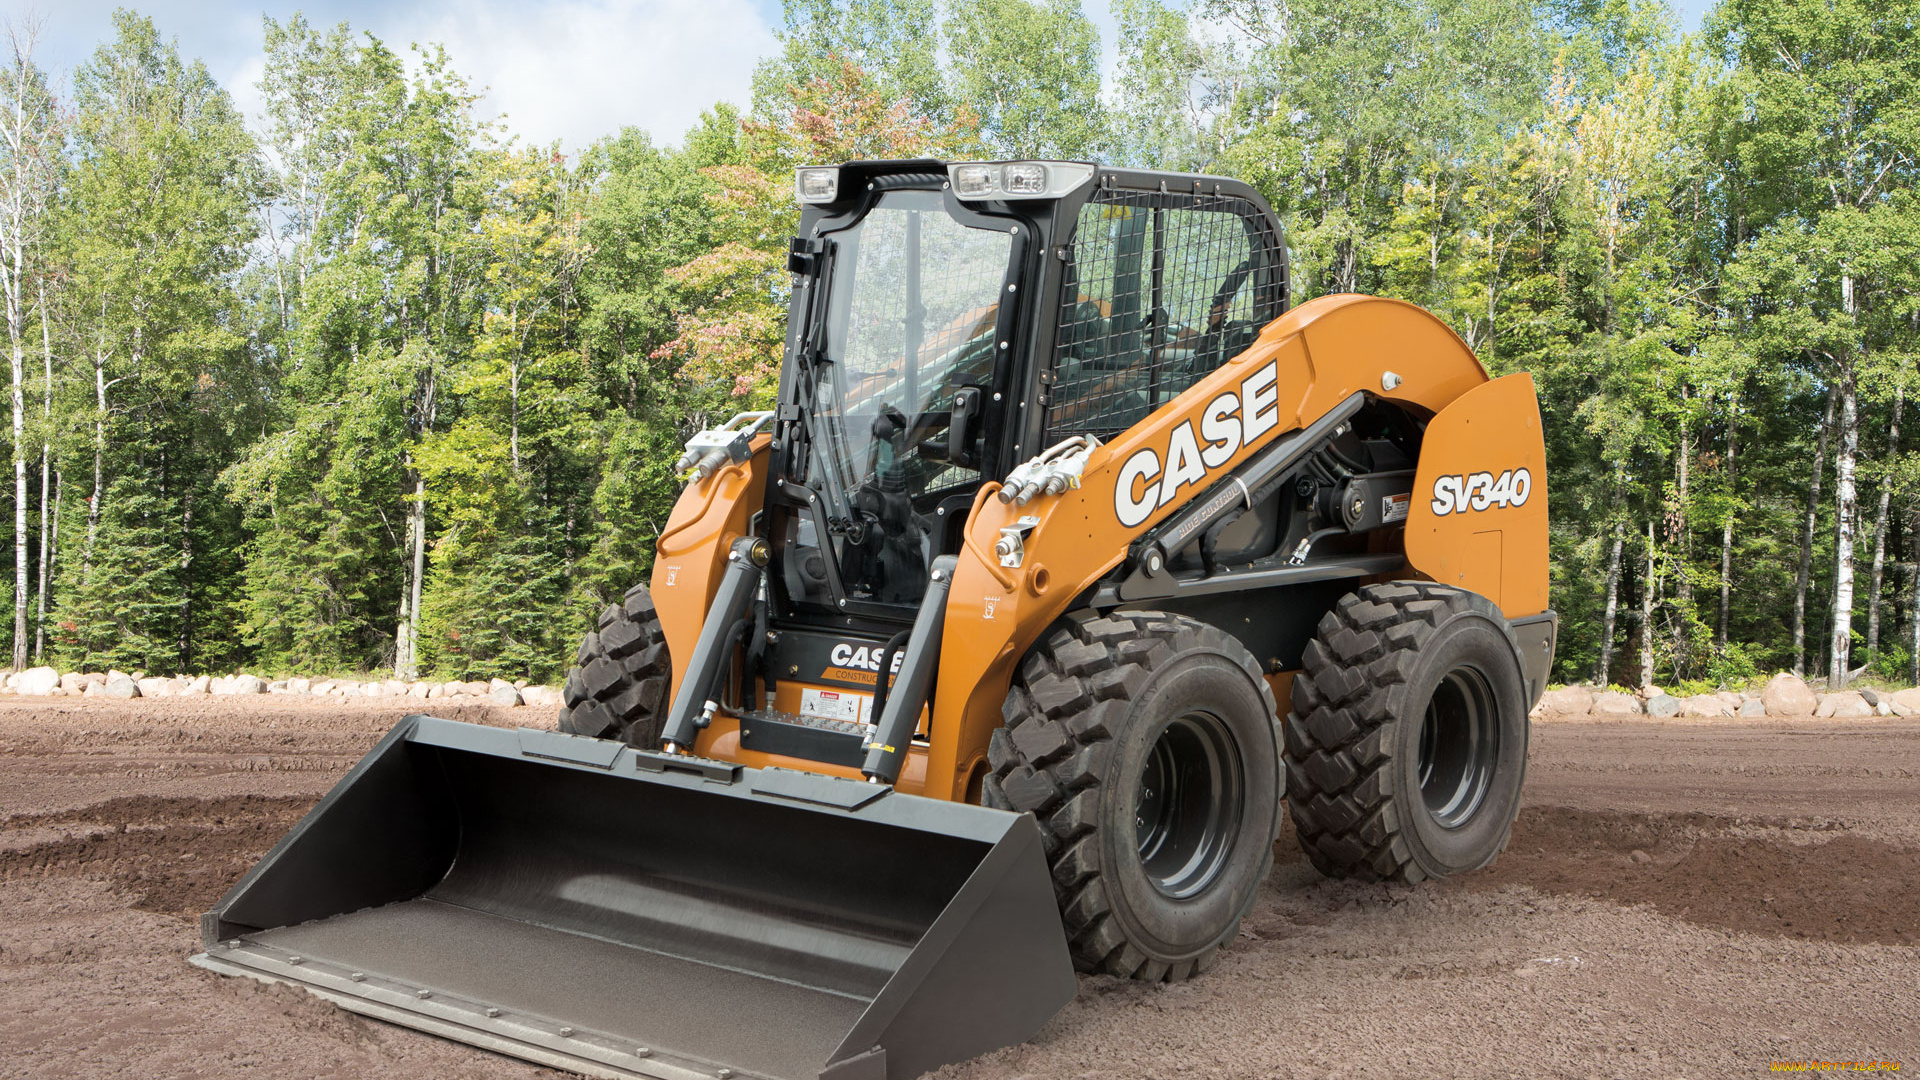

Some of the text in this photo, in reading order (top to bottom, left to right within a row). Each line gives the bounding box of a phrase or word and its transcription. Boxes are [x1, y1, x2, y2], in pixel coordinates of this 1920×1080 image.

[1114, 358, 1278, 528] CASE
[1431, 467, 1531, 516] SV340
[831, 643, 904, 673] CASE
[835, 670, 895, 686] CONSTRUCN
